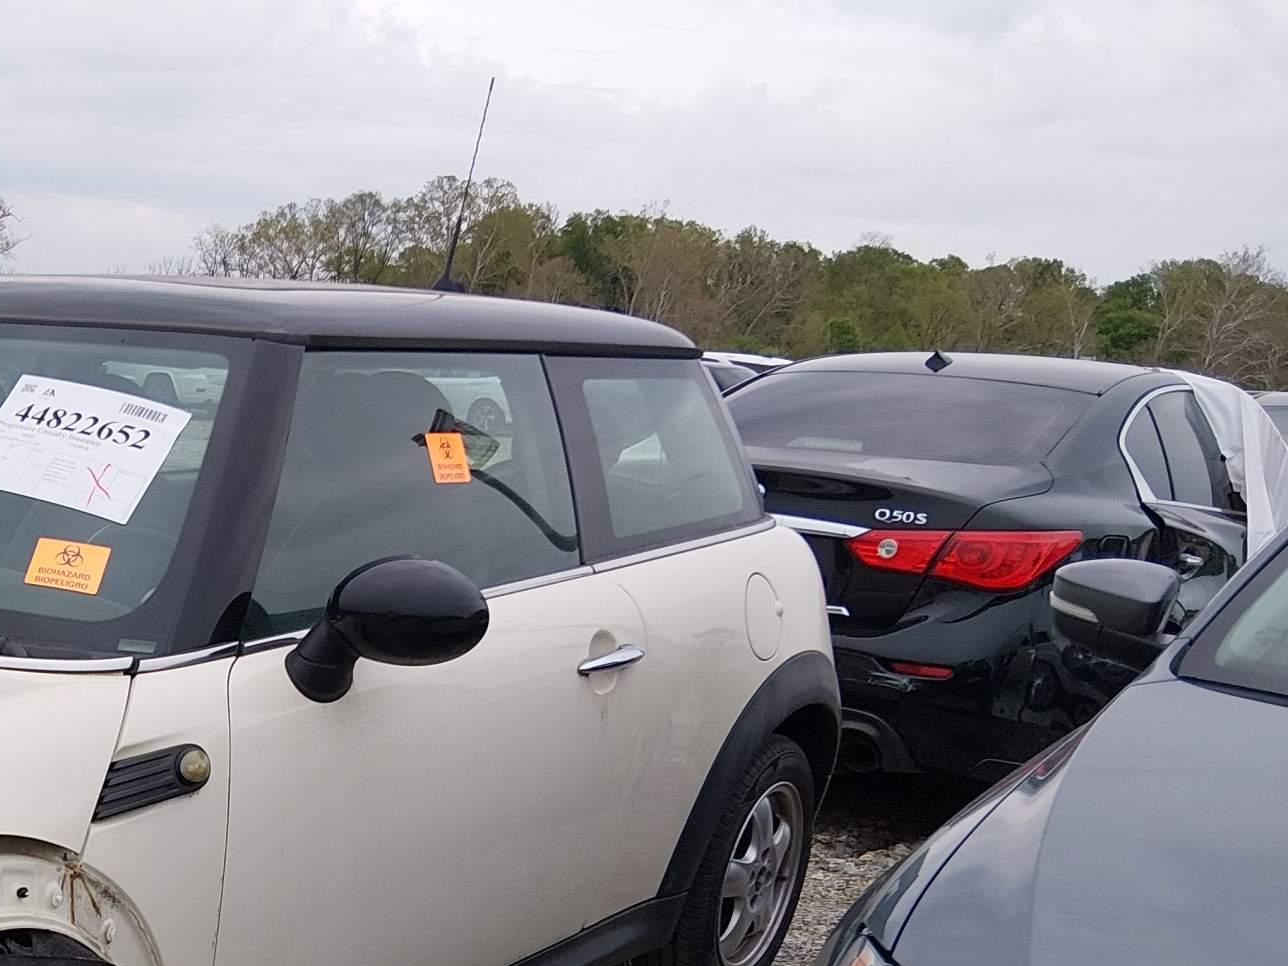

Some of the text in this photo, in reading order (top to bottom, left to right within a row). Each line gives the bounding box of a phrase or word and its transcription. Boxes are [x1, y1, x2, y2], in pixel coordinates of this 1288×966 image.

[15, 403, 151, 450] 44822652
[38, 567, 91, 581] BIOHAZARD
[34, 575, 88, 590] BIOPELIGRO
